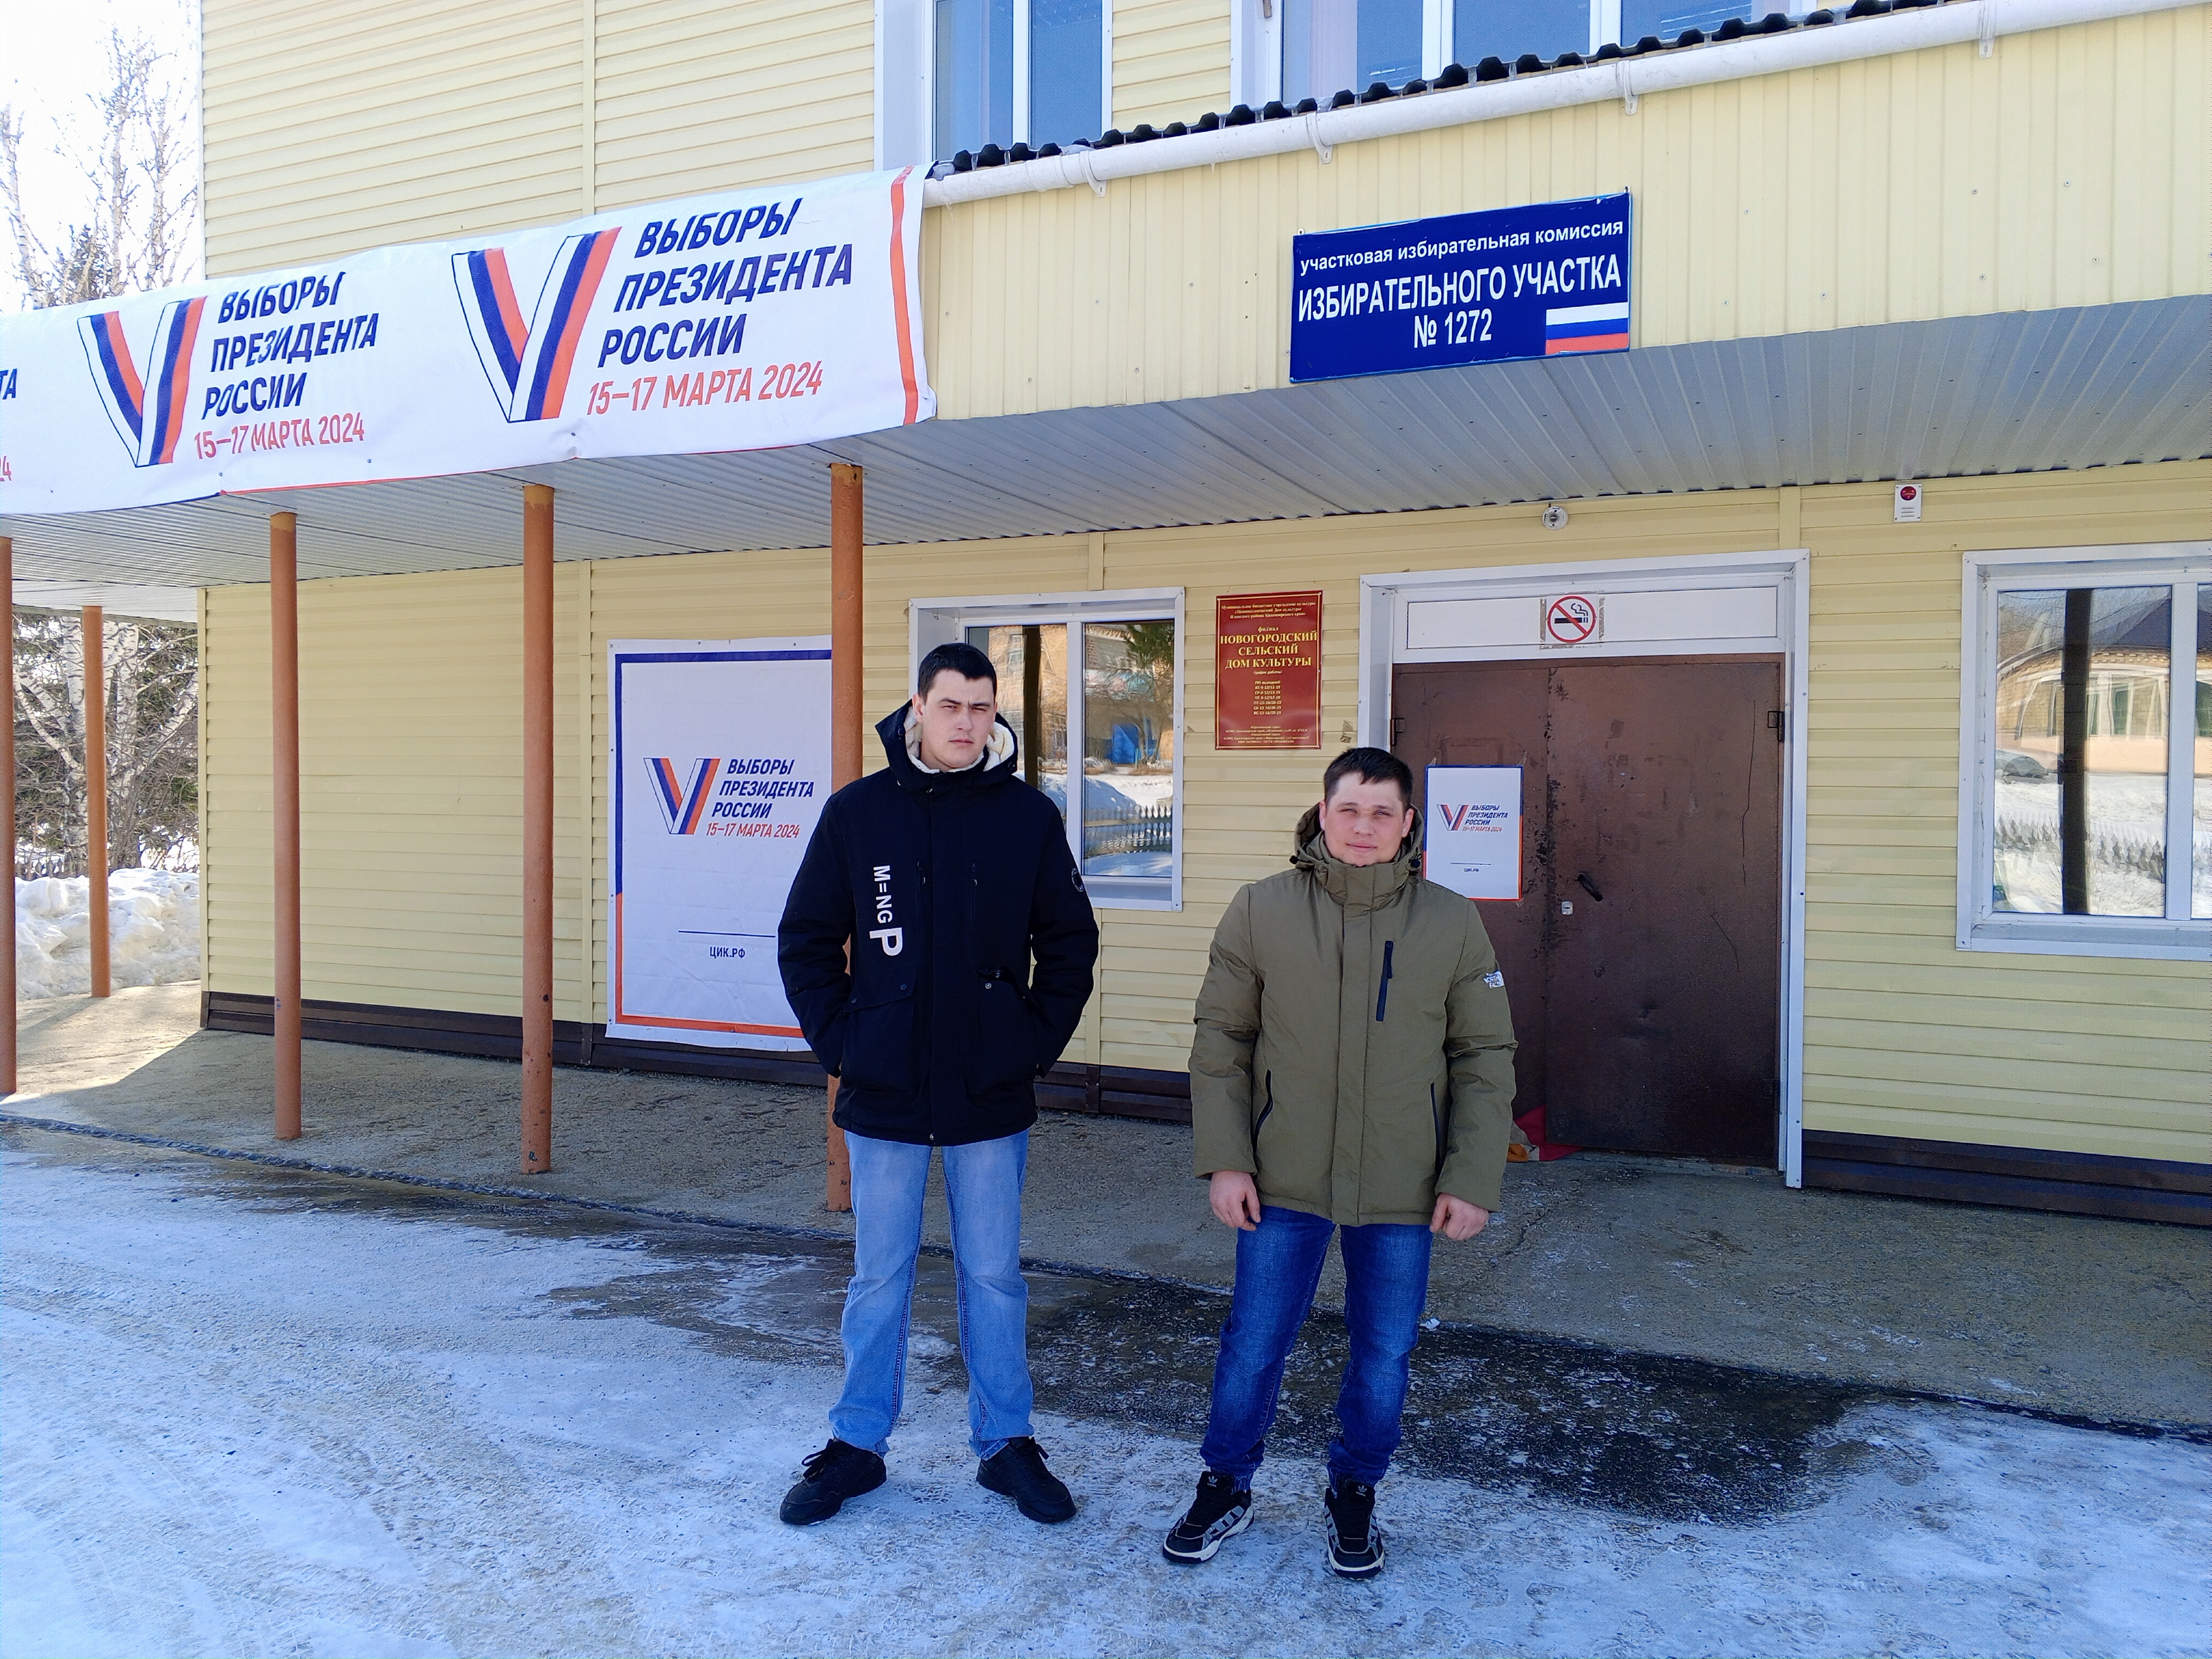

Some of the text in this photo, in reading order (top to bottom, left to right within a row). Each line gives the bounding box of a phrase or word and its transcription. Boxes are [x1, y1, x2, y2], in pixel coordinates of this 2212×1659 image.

[634, 198, 803, 259] ВЫБОРЫ
[1300, 221, 1623, 276] участковая избирательная комиссия
[217, 271, 346, 324] ВЫБОРЫ
[613, 244, 853, 314] ПРЕЗИДЕНТА
[1298, 254, 1621, 322] ИЗБИРАТЕЛЬНОГО УЧАСТКА
[211, 313, 380, 373] ПРЕЗИДЕНТА
[598, 313, 748, 368] РОССИИ
[1414, 309, 1492, 348] № 1272
[202, 372, 308, 420] РОССИИ
[662, 368, 752, 409] МАРТА
[758, 360, 823, 401] 2024
[251, 421, 314, 453] МАРТА
[318, 412, 365, 446] 2024
[1220, 630, 1317, 644] НОВОГОРОДСКИЙ
[1238, 643, 1298, 656] СЕЛЬСКИЙ
[1225, 657, 1312, 669] ДОМ КУЛЬТУРЫ
[727, 759, 795, 775] ВЫБОРЫ
[711, 802, 773, 818] РОССИИ
[718, 781, 814, 799] ПРЕЗИДЕНТА
[736, 823, 772, 837] МАРТА
[773, 824, 800, 838] 2024
[710, 947, 745, 958] ЦИК.РФ
[869, 927, 903, 956] P
